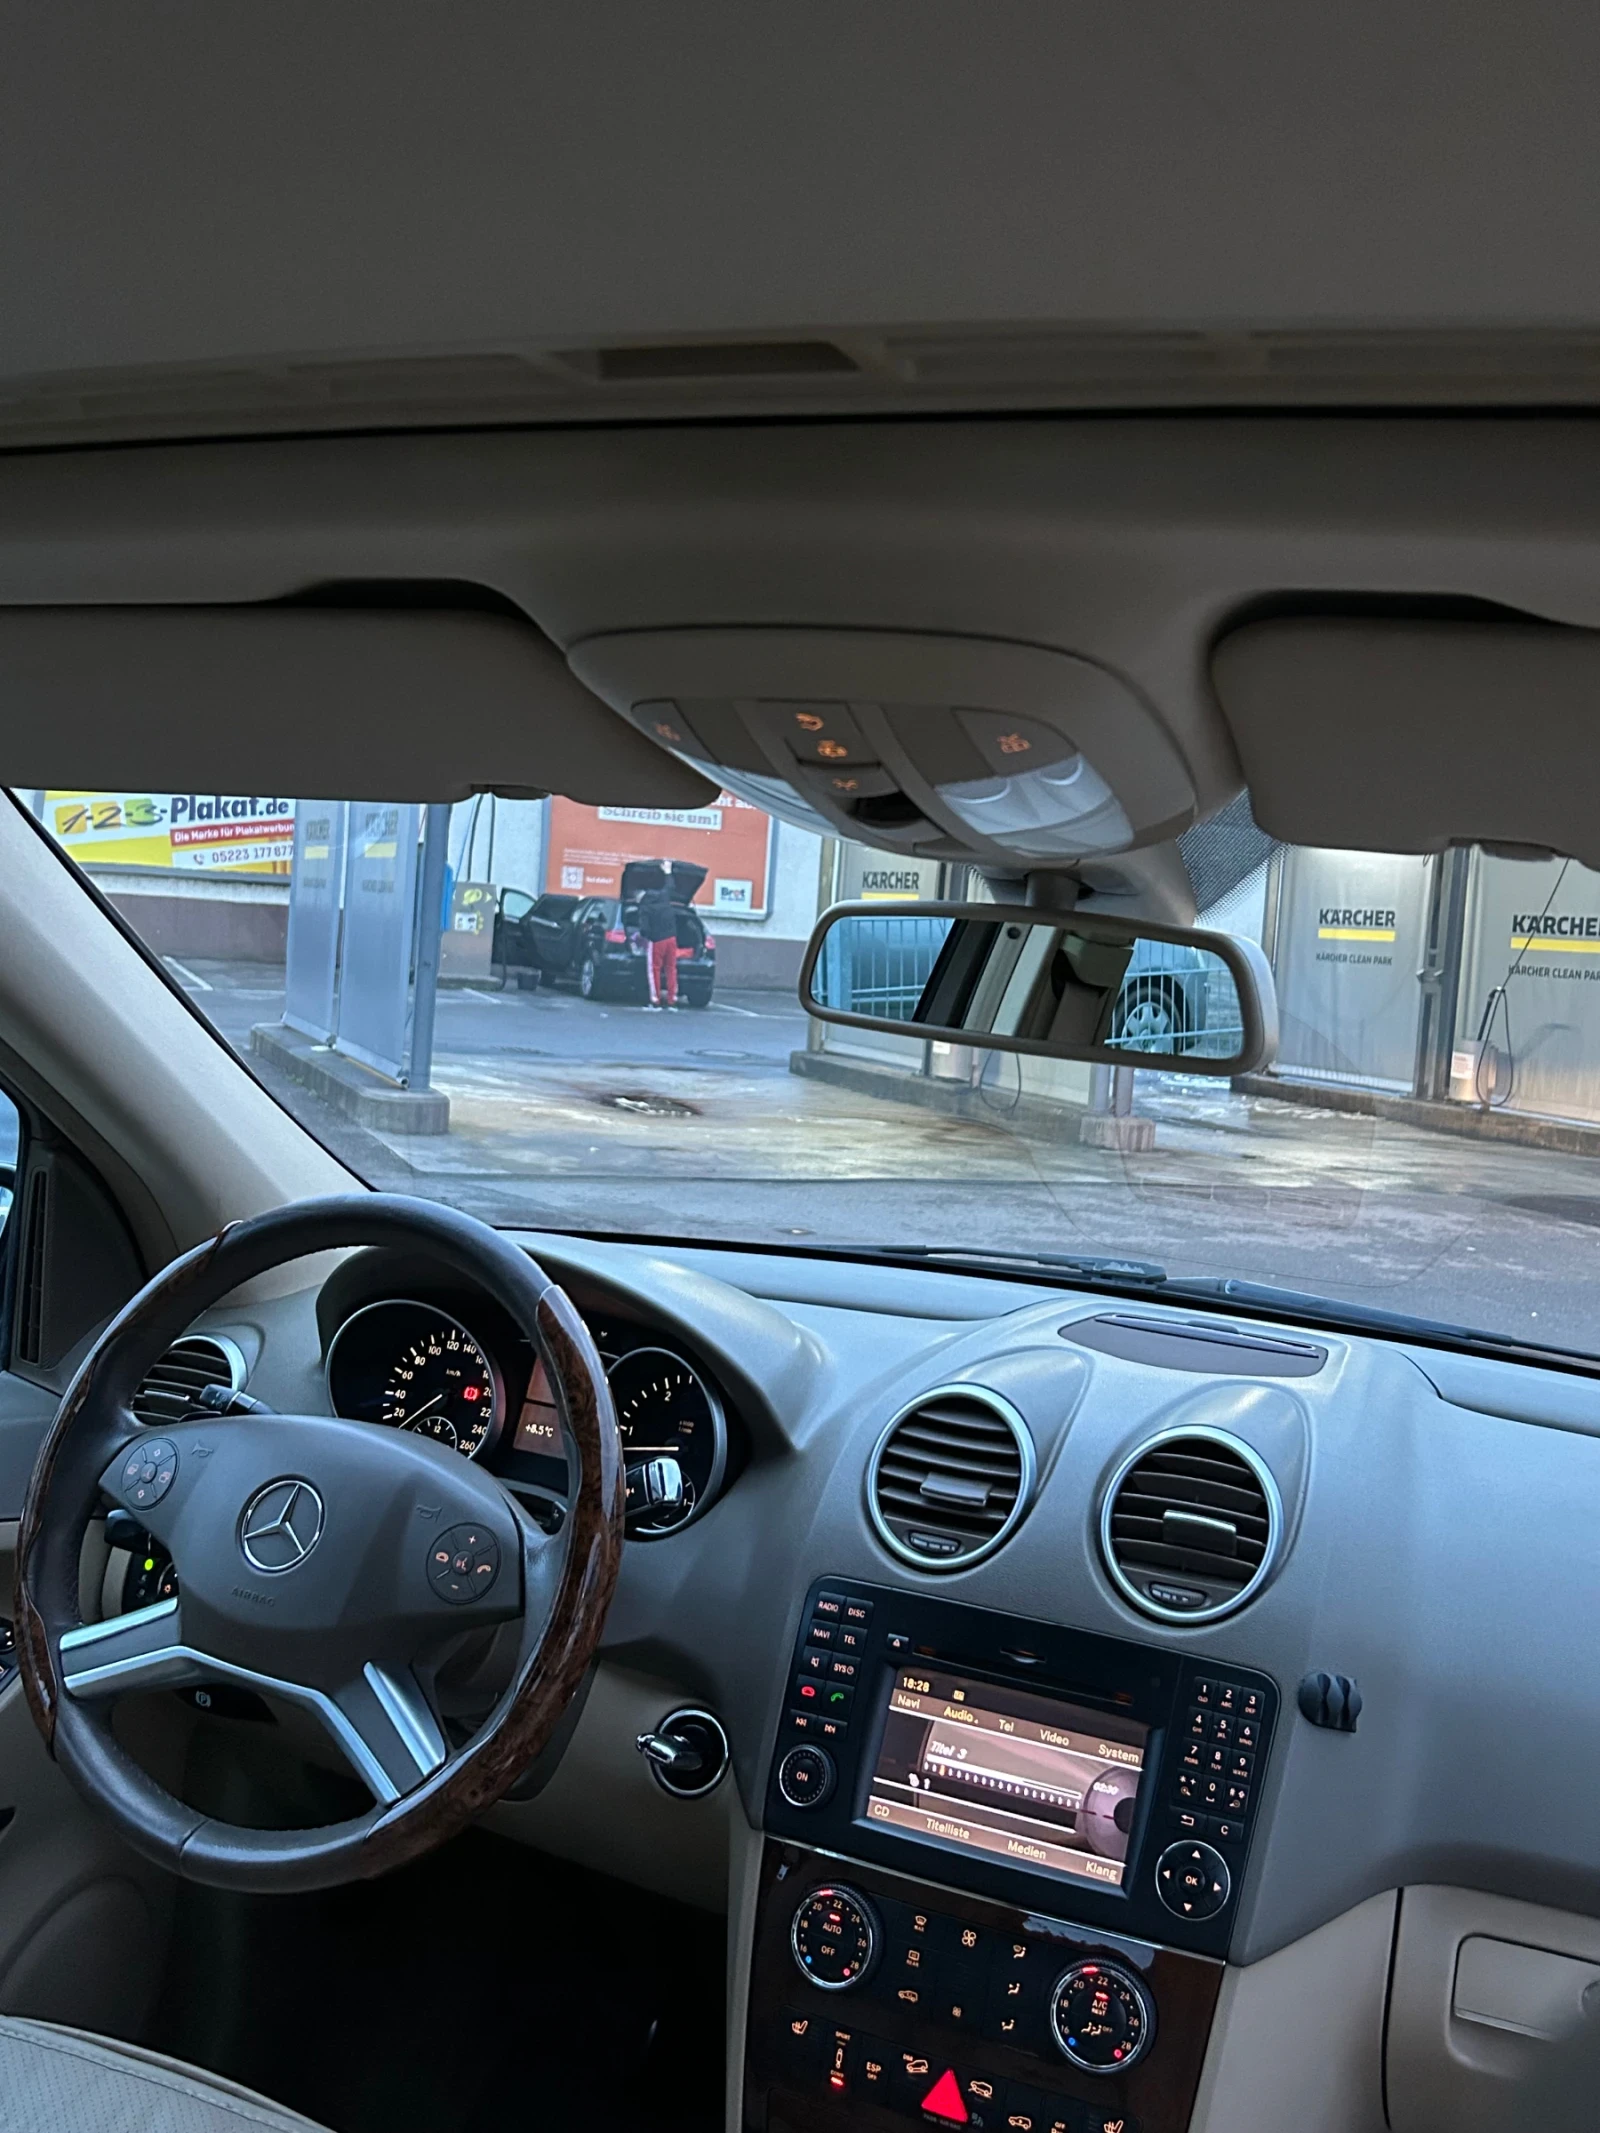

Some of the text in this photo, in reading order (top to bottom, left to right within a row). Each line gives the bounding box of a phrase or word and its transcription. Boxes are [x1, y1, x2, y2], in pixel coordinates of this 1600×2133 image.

[687, 813, 718, 826] um!
[174, 831, 190, 843] Die
[191, 828, 219, 840] Marke
[220, 826, 233, 837] für
[235, 823, 294, 836] Plakatwerbun
[212, 848, 249, 863] 05223
[1319, 908, 1396, 928] KÄRCHER
[1512, 914, 1600, 936] KÄRCHE
[1349, 953, 1372, 965] CLEAN
[1373, 955, 1393, 966] PARK
[1552, 967, 1582, 980] CLEAN
[428, 1345, 442, 1356] 100
[446, 1340, 460, 1351] 120
[463, 1344, 477, 1354] 140
[414, 1355, 426, 1366] 80
[402, 1370, 414, 1380] 60
[394, 1389, 406, 1399] 40
[664, 1391, 672, 1402] 2
[393, 1407, 405, 1418] 20
[480, 1407, 492, 1417] 22
[434, 1425, 441, 1434] 12
[471, 1424, 487, 1435] 240
[459, 1440, 475, 1451] 260
[818, 1600, 839, 1613] RADIO
[847, 1607, 866, 1619] DISC
[813, 1628, 831, 1640] NAVI
[844, 1634, 856, 1645] TEL
[833, 1662, 847, 1673] SYS
[903, 1677, 930, 1693] 18:28
[1202, 1684, 1207, 1693] 1
[1225, 1689, 1232, 1699] 2
[1248, 1695, 1256, 1705] 3
[1195, 1714, 1202, 1724] 4
[897, 1694, 1140, 1763] Navi Audio Tel Video System
[1219, 1720, 1227, 1729] 5
[1243, 1726, 1251, 1736] 6
[930, 1740, 956, 1756] Titel
[1191, 1745, 1198, 1754] 7
[1214, 1751, 1222, 1761] 8
[1239, 1757, 1246, 1767] 9
[796, 1771, 809, 1782] ON
[1209, 1782, 1216, 1792] 0
[1220, 1825, 1229, 1835] C
[874, 1804, 1118, 1881] CD Titelliste Medien Klang
[1185, 1875, 1198, 1886] OK
[812, 1902, 823, 1911] 20
[832, 1899, 843, 1909] 22
[851, 1914, 860, 1923] 24
[800, 1920, 808, 1929] 18
[822, 1922, 842, 1935] AUTO
[857, 1938, 867, 1947] 26
[800, 1944, 807, 1953] 16
[821, 1945, 836, 1956] OFF
[850, 1960, 860, 1970] 28
[1073, 1980, 1084, 1989] 20
[1097, 1976, 1108, 1986] 22
[1120, 1991, 1130, 2001] 24
[1060, 1999, 1069, 2008] 18
[1092, 1999, 1108, 2010] A/C
[1128, 2017, 1139, 2026] 26
[1061, 2025, 1069, 2034] 16
[1120, 2040, 1132, 2050] 28
[866, 2061, 881, 2073] ESP
